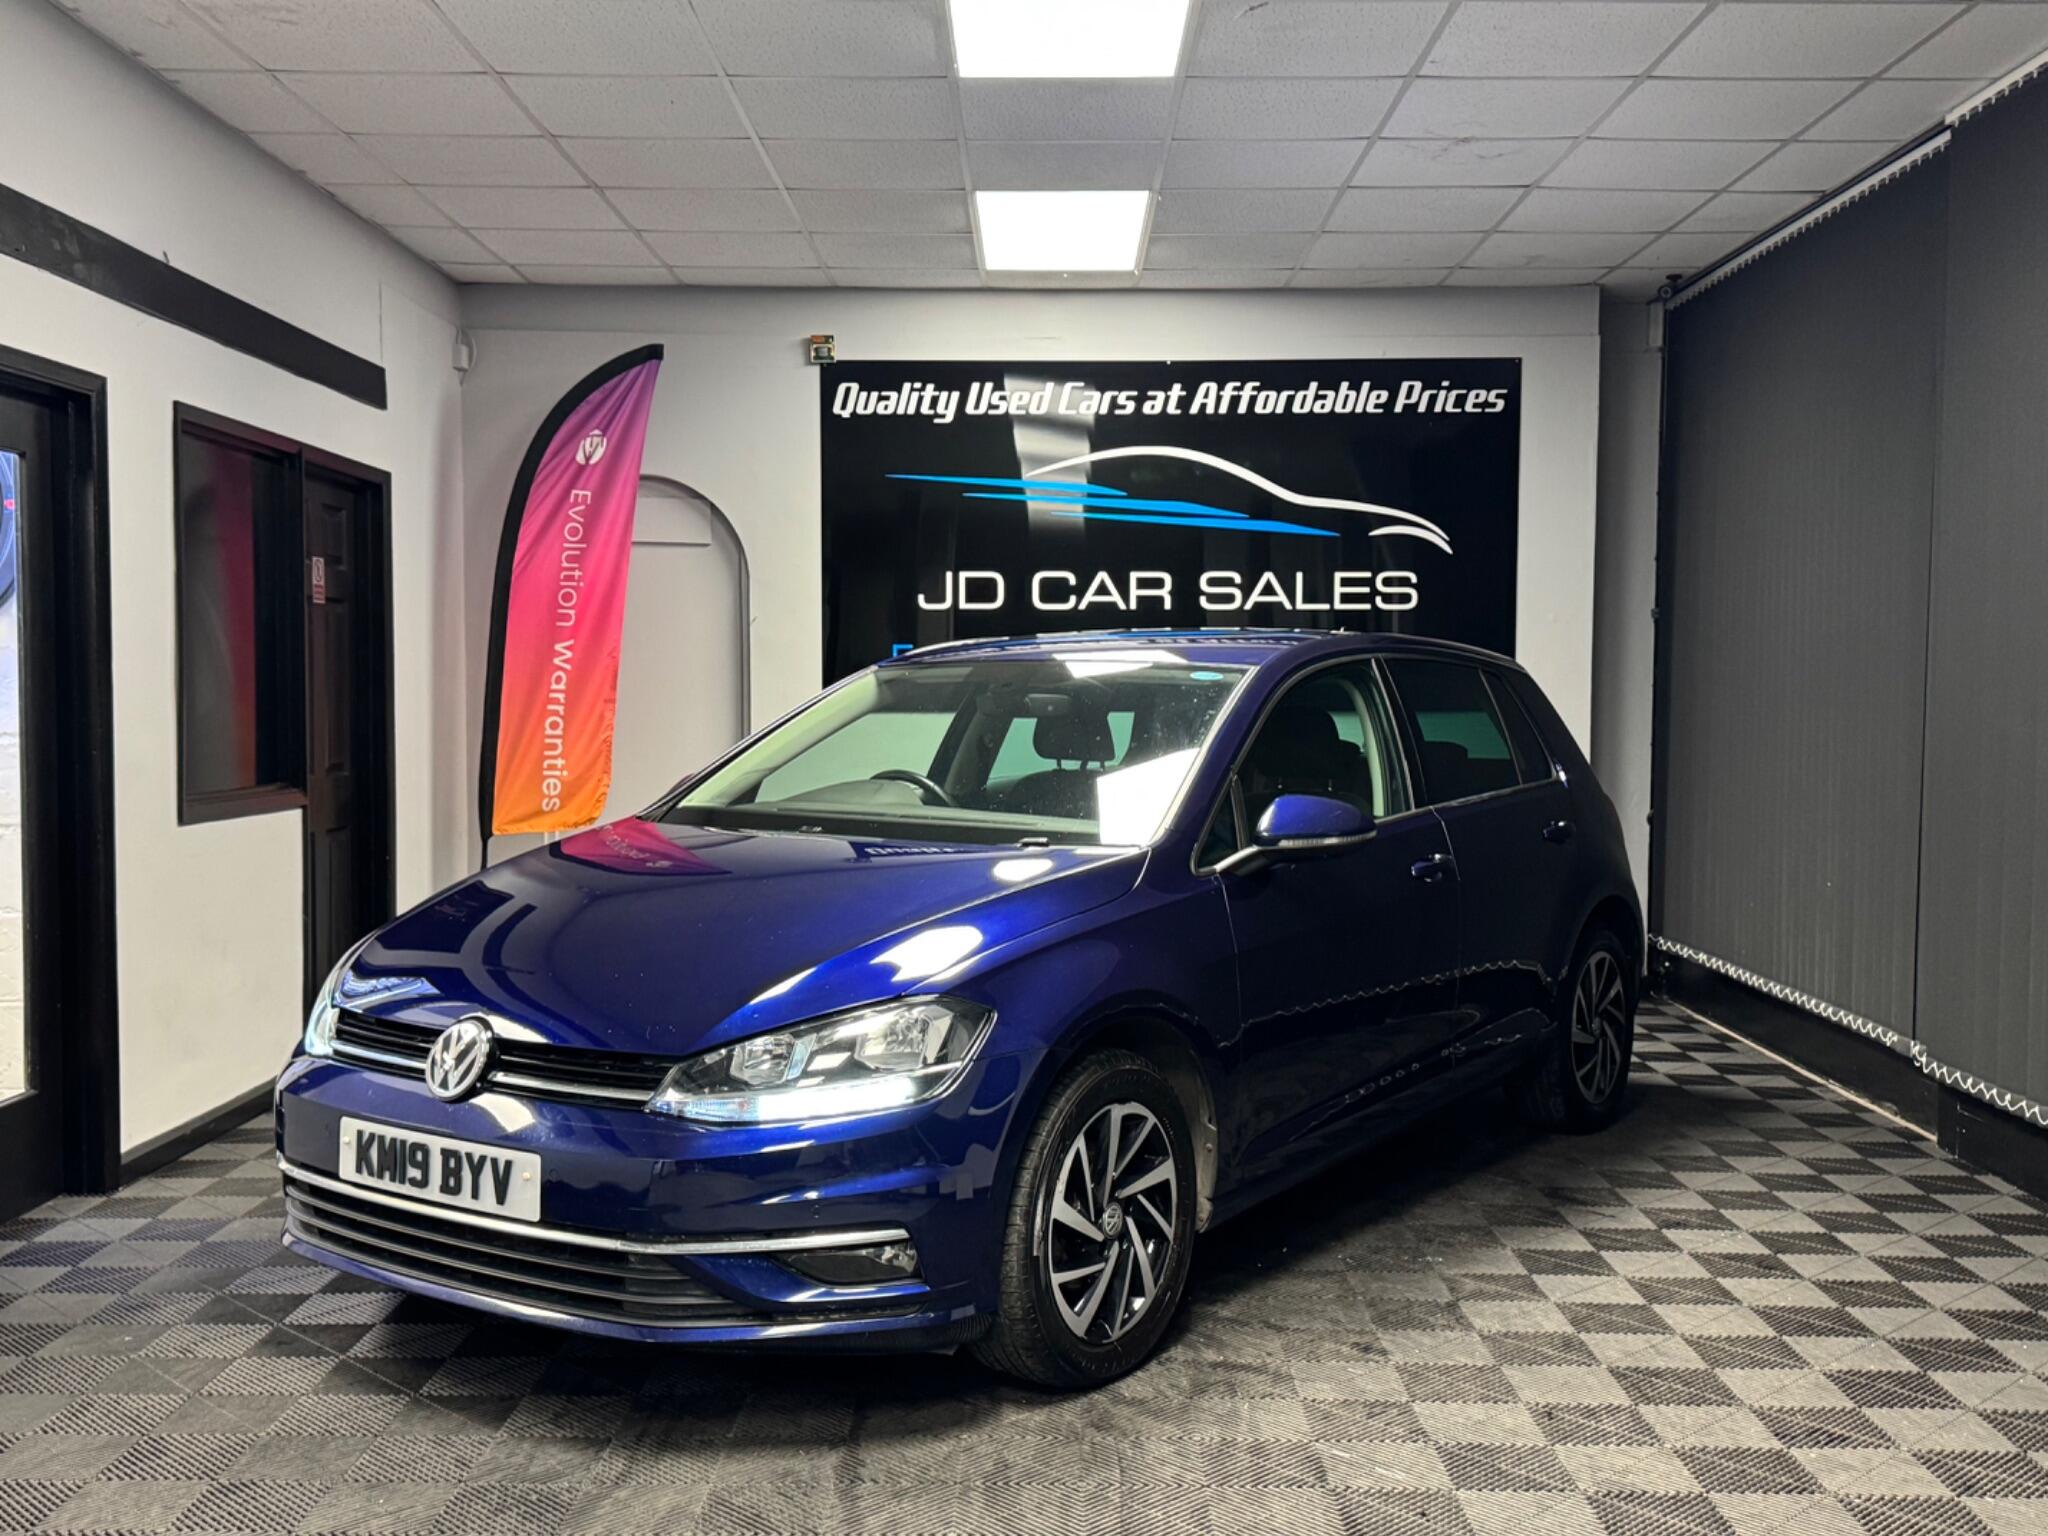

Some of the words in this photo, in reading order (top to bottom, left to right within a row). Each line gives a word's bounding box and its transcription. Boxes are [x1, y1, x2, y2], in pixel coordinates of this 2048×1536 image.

[832, 382, 960, 424] Quality
[965, 382, 1055, 415] Used
[1058, 382, 1138, 415] Cars
[1142, 382, 1186, 415] at
[1189, 381, 1389, 415] Affordable
[1394, 381, 1508, 413] Prices
[555, 489, 592, 627] Evolution
[917, 571, 1005, 611] JD
[1031, 571, 1172, 611] CAR
[1198, 571, 1419, 611] SALES
[542, 640, 575, 812] warranties
[355, 1129, 430, 1190] KM19
[440, 1147, 513, 1206] BYV
